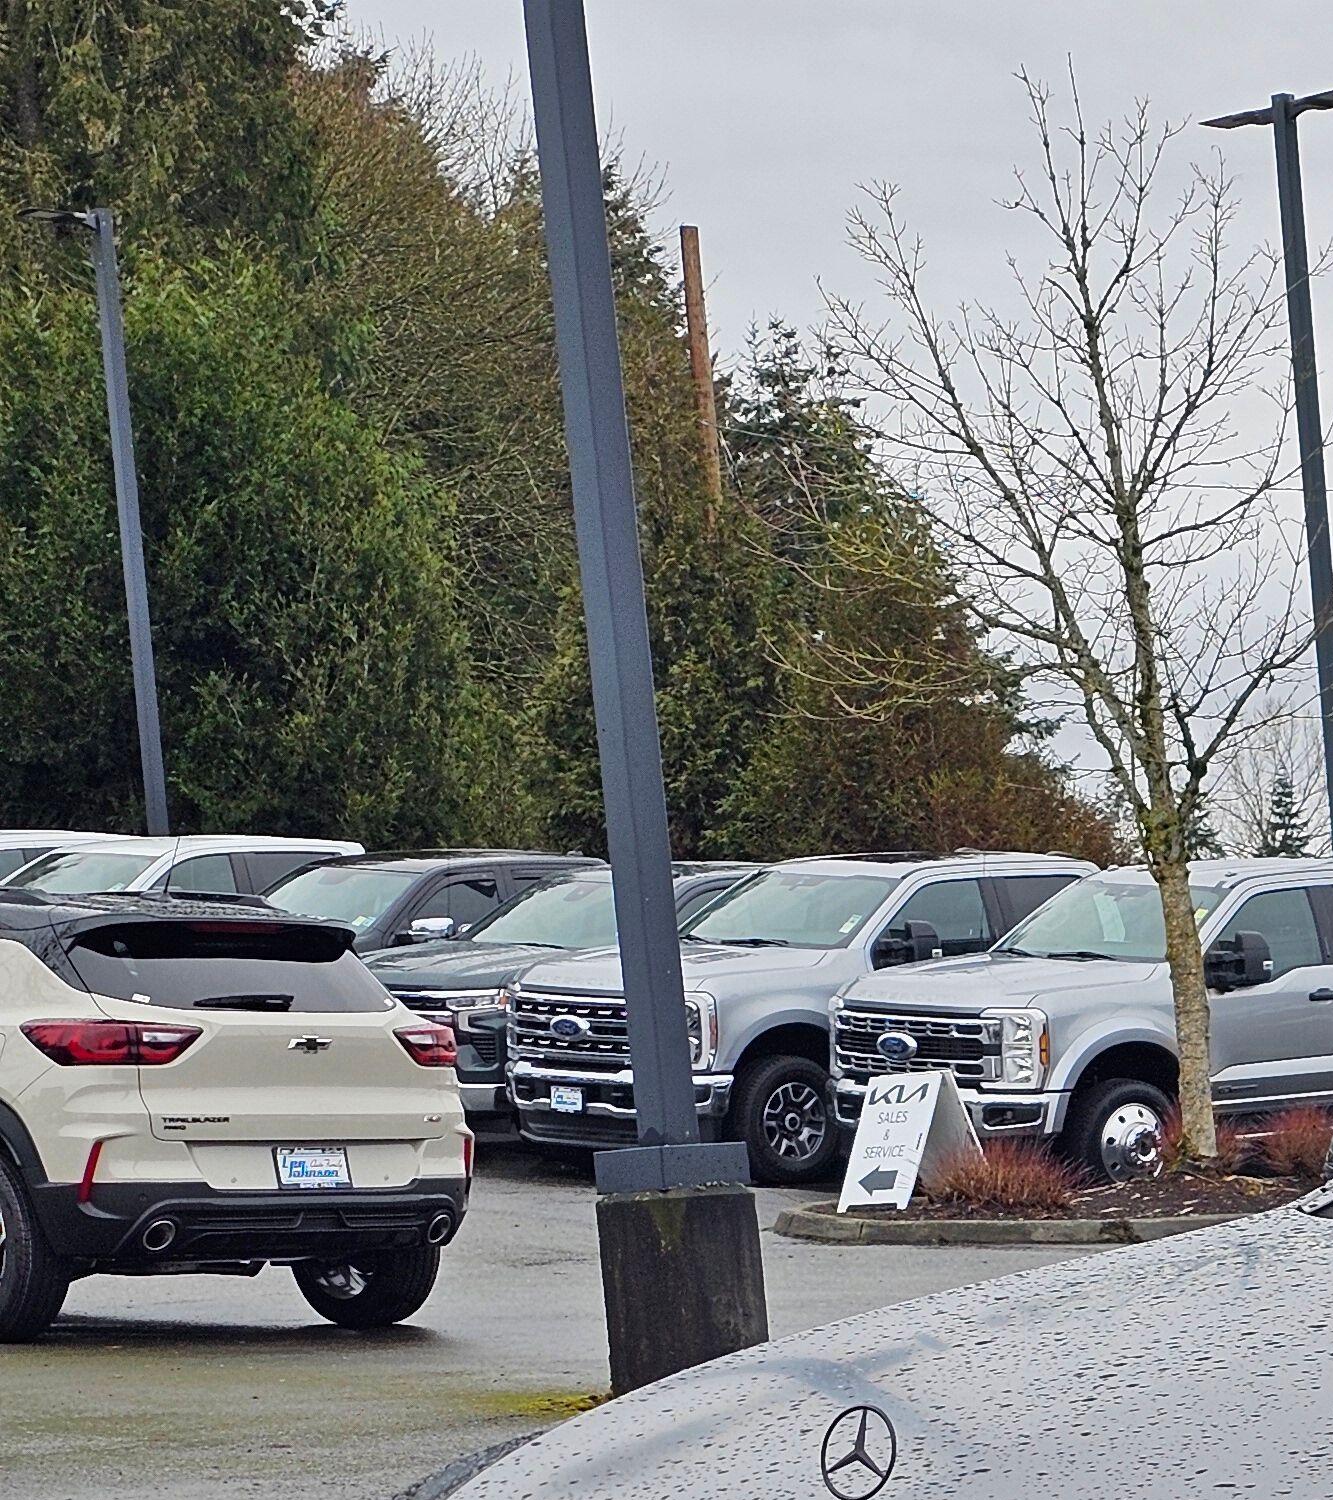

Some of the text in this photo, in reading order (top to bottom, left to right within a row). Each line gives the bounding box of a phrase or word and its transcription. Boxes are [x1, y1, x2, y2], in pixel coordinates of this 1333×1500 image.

[868, 1083, 930, 1106] KIA
[878, 1111, 908, 1124] SALES
[883, 1128, 890, 1141] &
[863, 1144, 906, 1159] SERVICE
